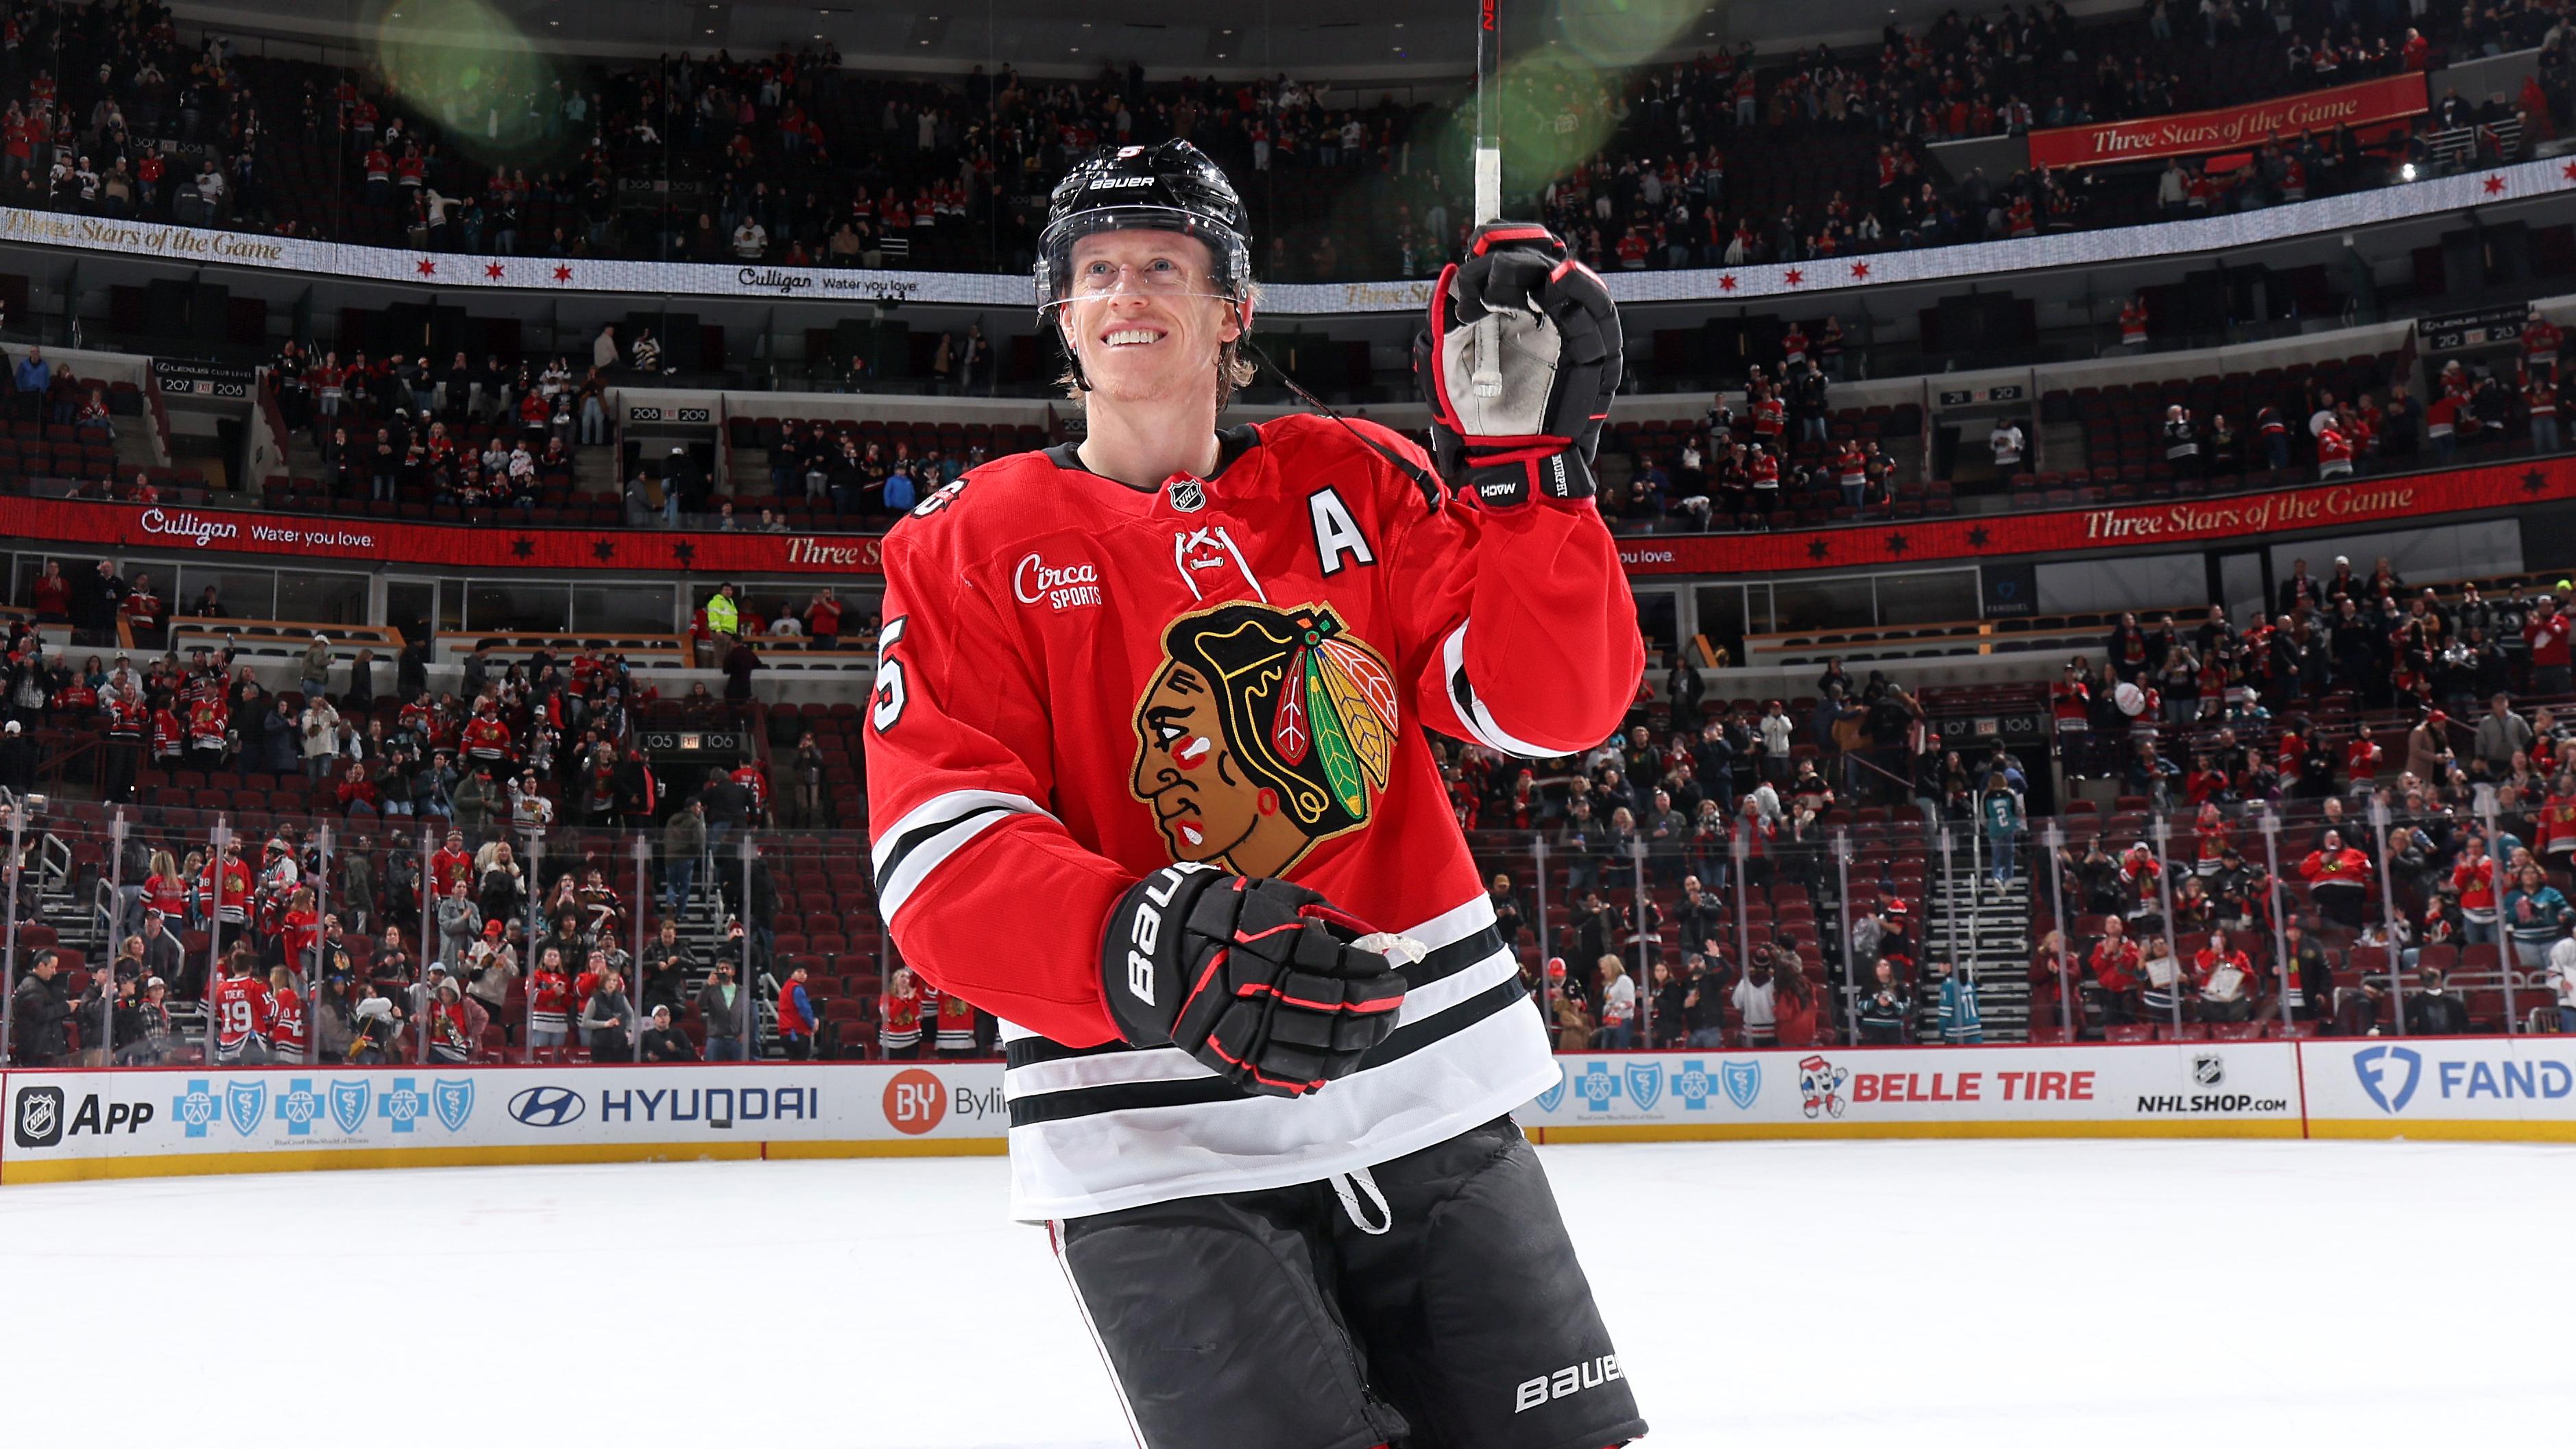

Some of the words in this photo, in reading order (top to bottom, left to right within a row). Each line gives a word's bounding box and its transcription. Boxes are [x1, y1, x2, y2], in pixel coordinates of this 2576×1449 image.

[2093, 130, 2154, 153] Three
[2160, 123, 2219, 146] Stars
[2224, 114, 2250, 143] of
[2250, 111, 2283, 134] the
[2289, 99, 2357, 125] Game
[6, 208, 74, 237] Three
[78, 218, 141, 245] Stars
[145, 226, 172, 252] of
[172, 230, 208, 253] the
[213, 232, 282, 260] Game
[738, 268, 811, 293] Culligan
[823, 278, 860, 290] Water
[865, 280, 887, 293] you
[166, 379, 189, 391] 207
[217, 383, 243, 395] 208
[634, 409, 658, 419] 208
[681, 410, 707, 420] 209
[1480, 482, 1517, 498] MACH
[1551, 453, 1568, 498] MURPHY
[1179, 488, 1196, 507] NHL
[141, 507, 237, 546] Culligan
[251, 525, 300, 541] Water
[305, 531, 335, 547] you
[2084, 509, 2163, 539] Three
[2169, 506, 2241, 534] Stars
[2245, 497, 2276, 531] of
[2278, 495, 2322, 522] the
[2326, 487, 2414, 515] Game
[1307, 485, 1375, 576] A
[785, 537, 858, 565] Three
[1619, 552, 1638, 563] ou
[1641, 549, 1675, 563] love.
[1014, 553, 1098, 604] Circa
[1050, 586, 1102, 609] SPORTS
[874, 616, 906, 733] 5
[647, 735, 673, 748] 105
[681, 735, 699, 748] EXIT
[707, 735, 734, 748] 106
[1944, 720, 1966, 735] 107
[1996, 807, 2009, 827] 2
[224, 989, 245, 1000] TOEWS
[221, 1000, 253, 1034] 19
[1852, 1072, 1982, 1103] BELLE
[1997, 1071, 2095, 1101] TIRE
[2438, 1060, 2573, 1099] FAND
[29, 1104, 51, 1130] NHL
[601, 1086, 819, 1123] HYUNDAI
[896, 1084, 936, 1122] BY
